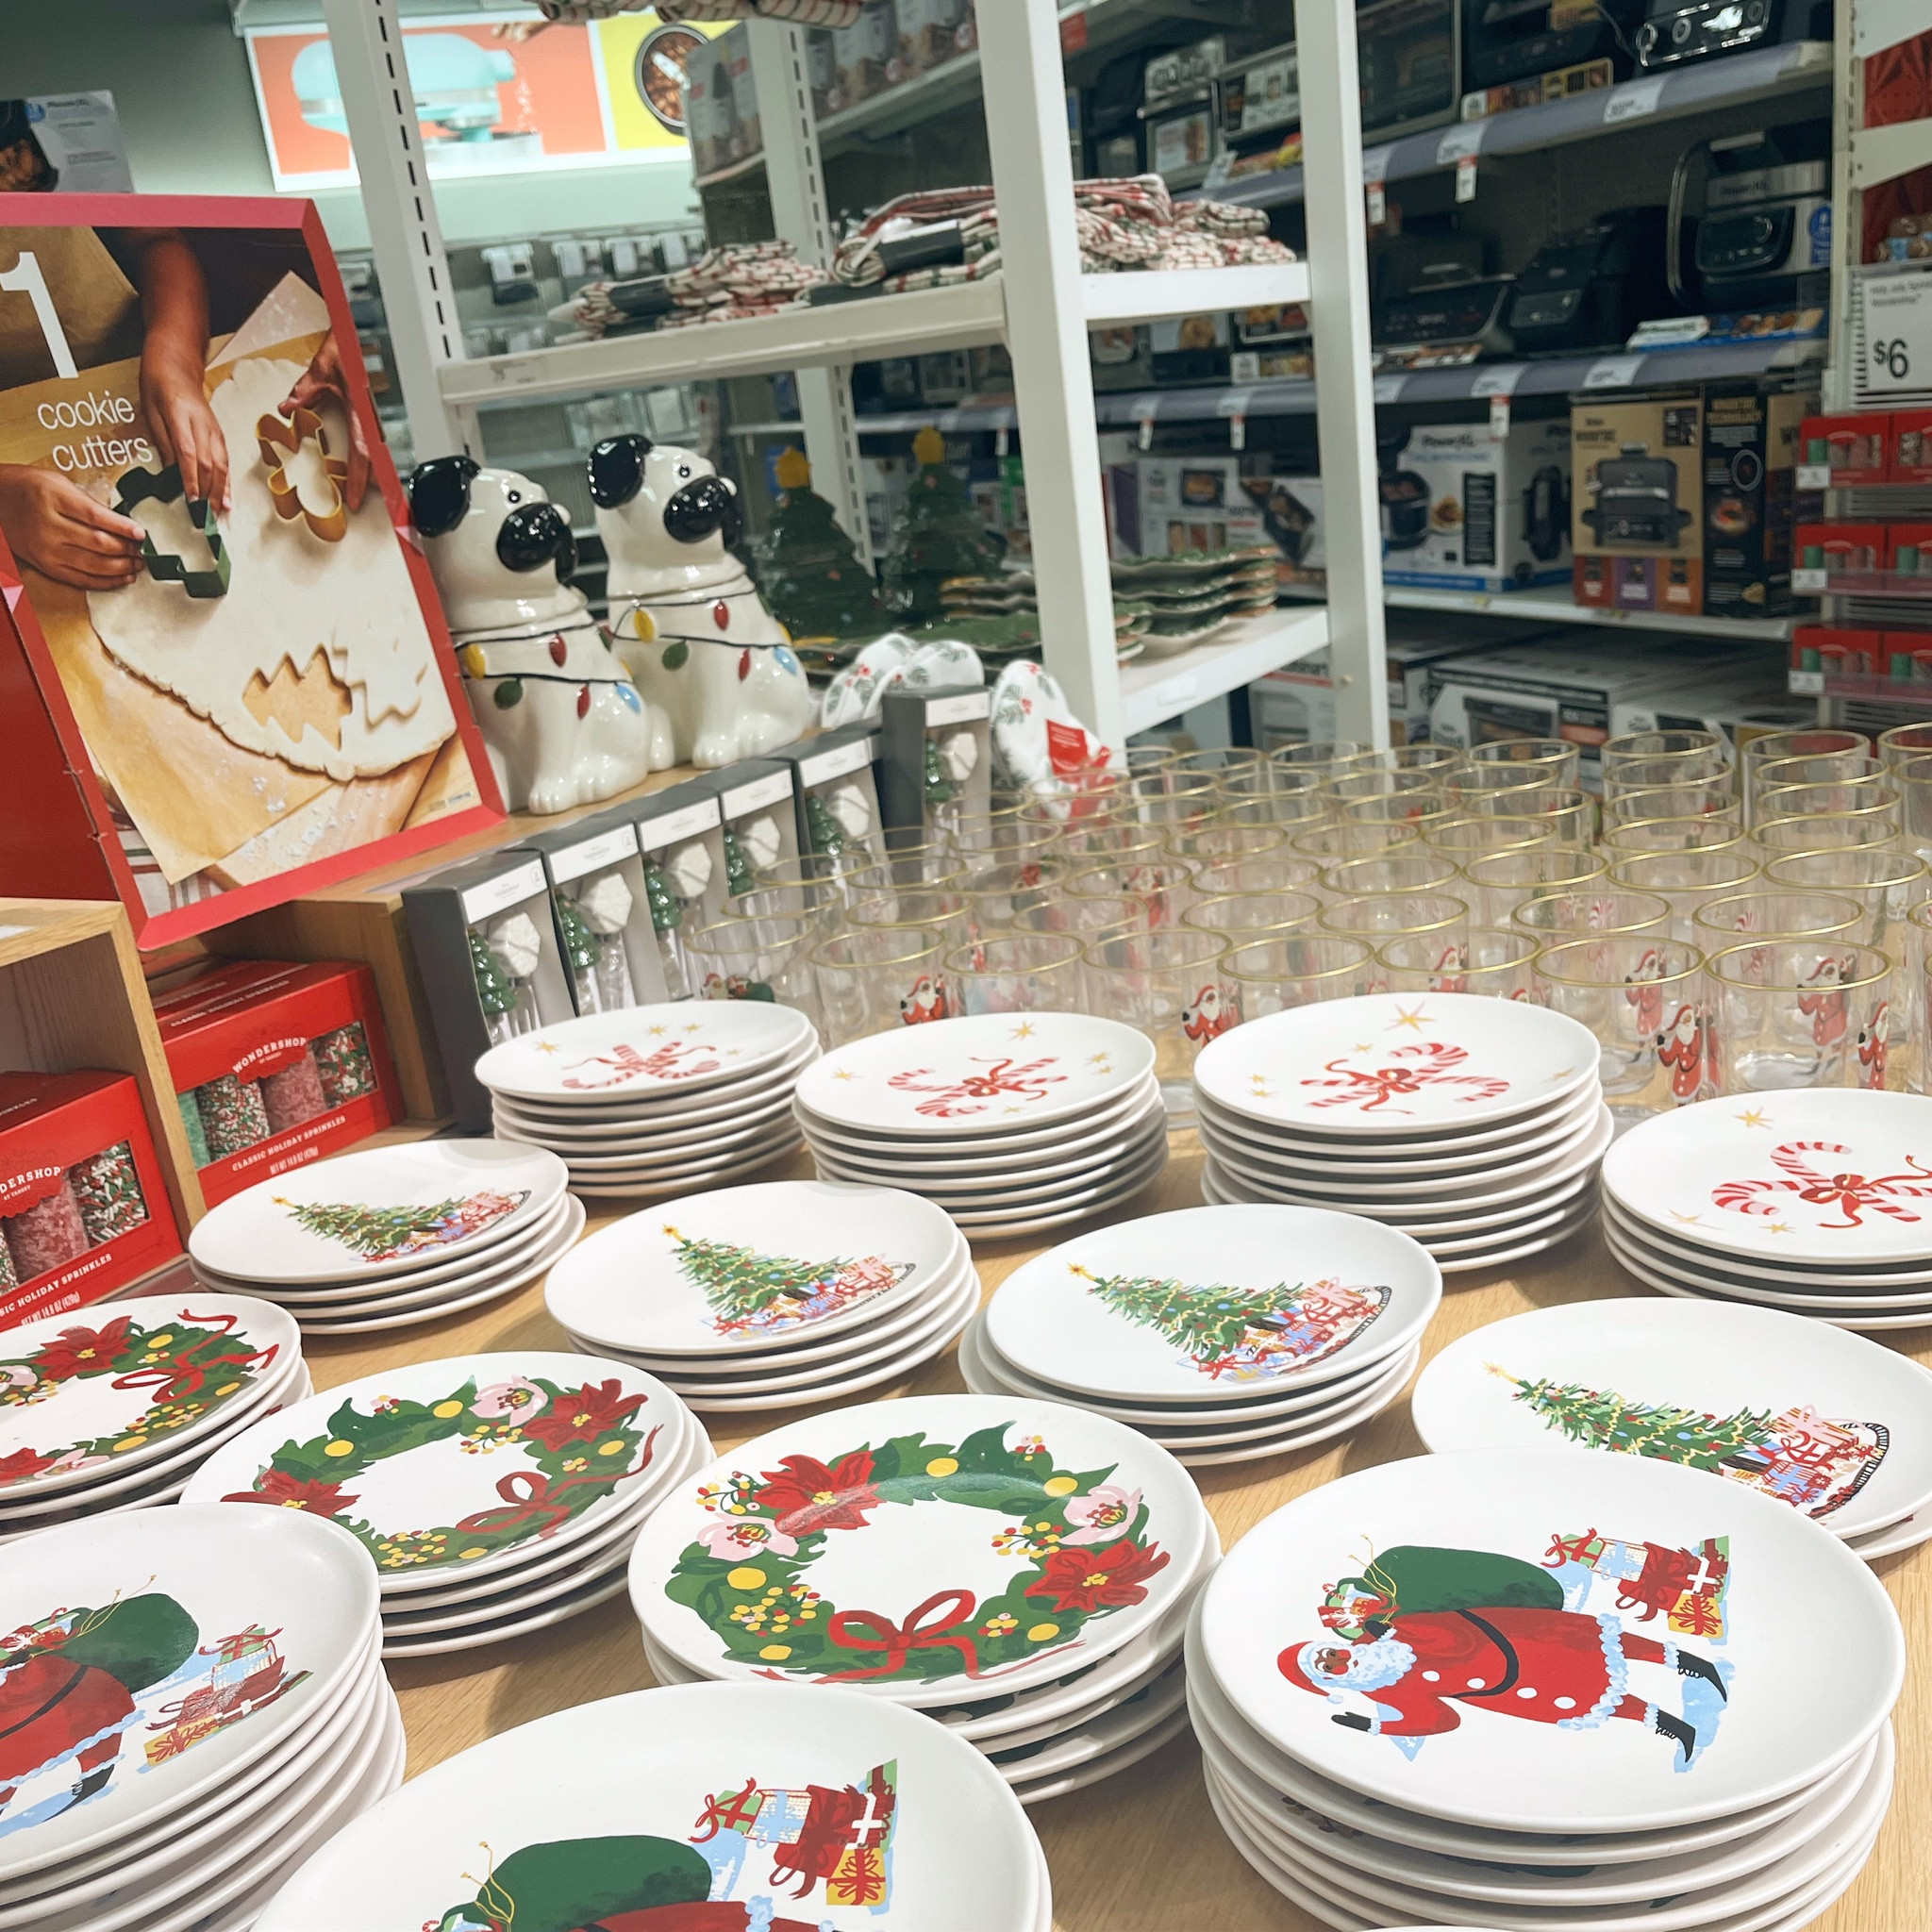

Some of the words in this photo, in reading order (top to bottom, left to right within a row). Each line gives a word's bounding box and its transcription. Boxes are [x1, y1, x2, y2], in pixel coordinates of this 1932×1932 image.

[0, 252, 79, 379] 1
[1873, 338, 1909, 380] $6
[37, 390, 135, 430] cookie
[52, 435, 153, 472] cutters
[232, 1037, 307, 1074] WONDERSHOP
[232, 1150, 266, 1172] CLASSIC
[267, 1134, 303, 1156] HOLIDAY
[303, 1114, 346, 1140] SPRINKLES
[17, 1279, 59, 1307] HOLIDAY
[61, 1253, 112, 1285] SPRINKLES
